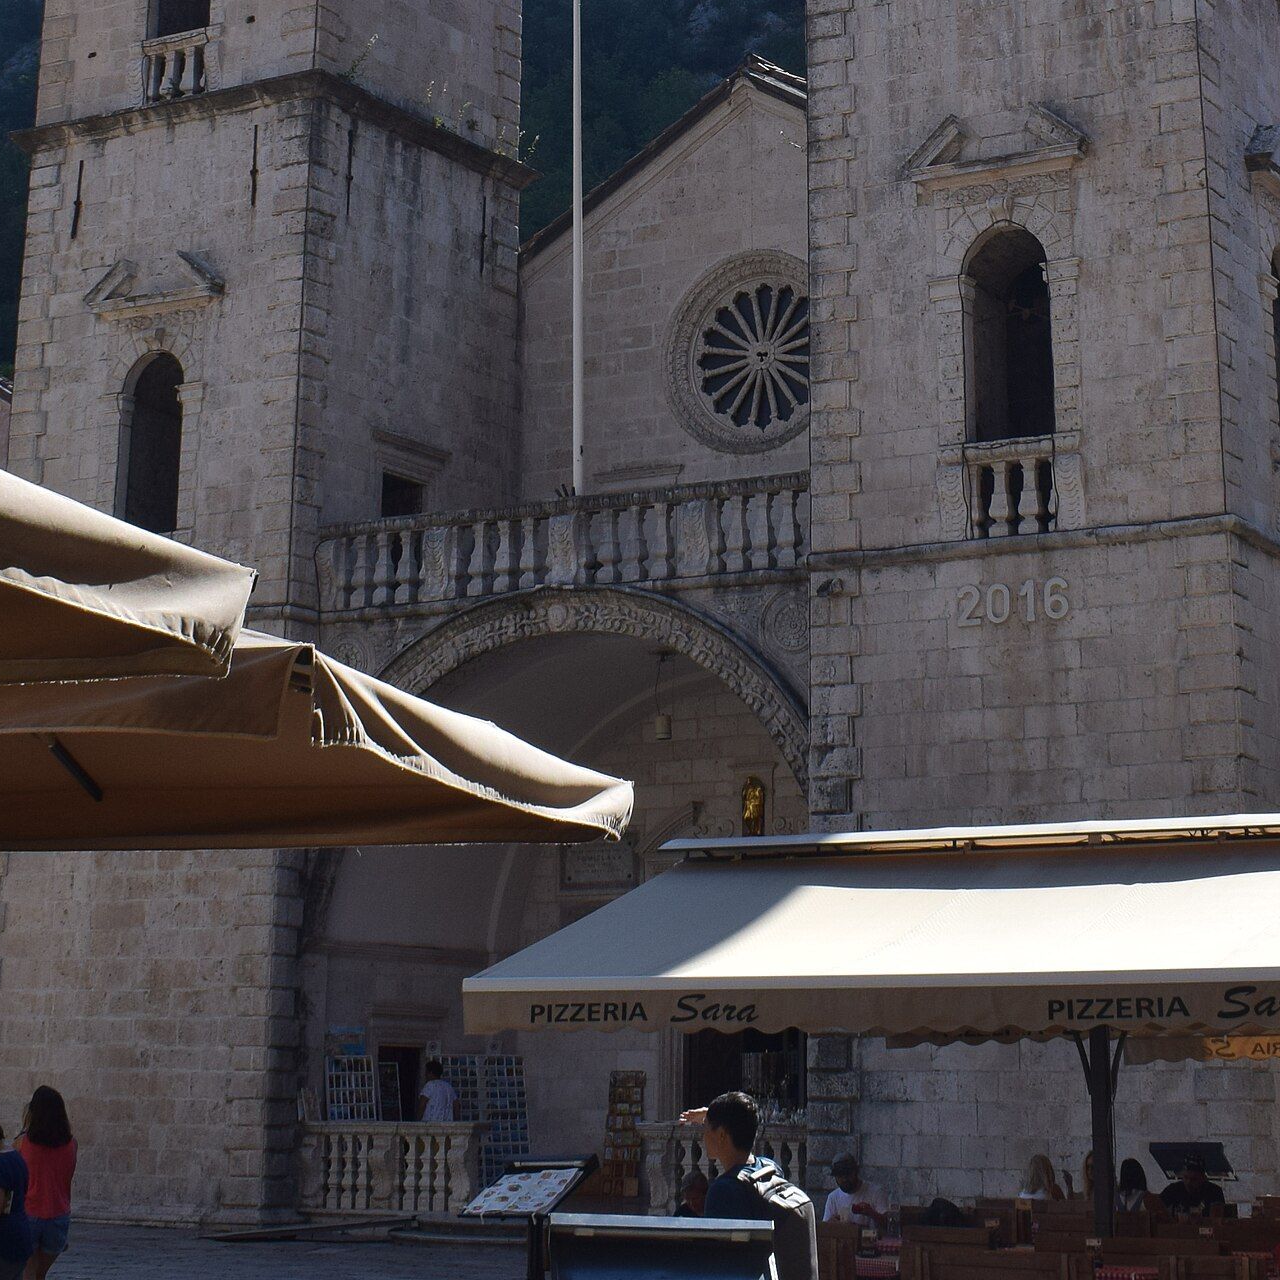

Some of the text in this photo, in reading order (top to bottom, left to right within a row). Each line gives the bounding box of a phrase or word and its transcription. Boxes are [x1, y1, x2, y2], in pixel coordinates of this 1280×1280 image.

[956, 576, 1069, 627] 2016
[530, 993, 759, 1023] PIZZERIA Sara
[1048, 996, 1190, 1020] PIZZERIA
